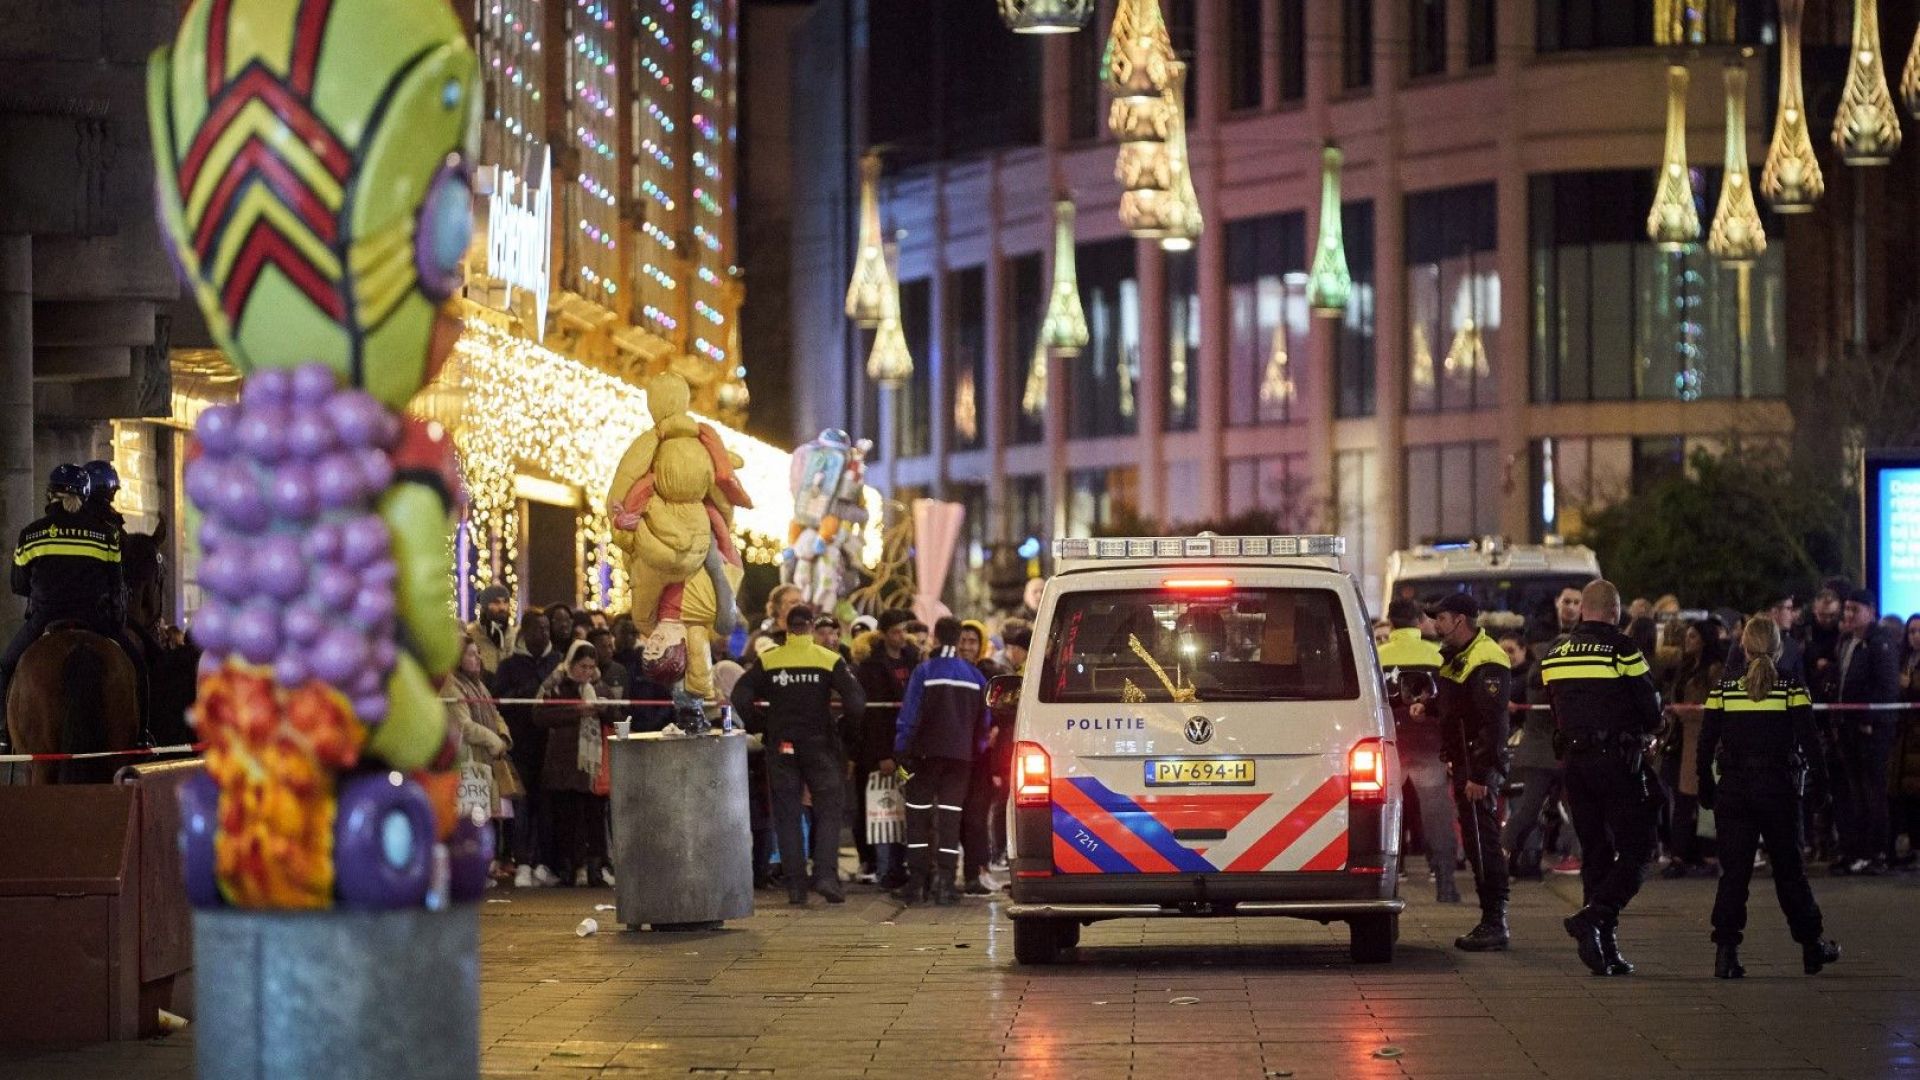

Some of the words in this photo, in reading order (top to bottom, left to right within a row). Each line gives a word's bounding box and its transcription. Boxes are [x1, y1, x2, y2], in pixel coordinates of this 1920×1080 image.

[1067, 718, 1145, 730] POLITIE
[1159, 764, 1247, 779] PV-694-H
[456, 784, 489, 798] ORK
[1075, 829, 1098, 851] 7211
